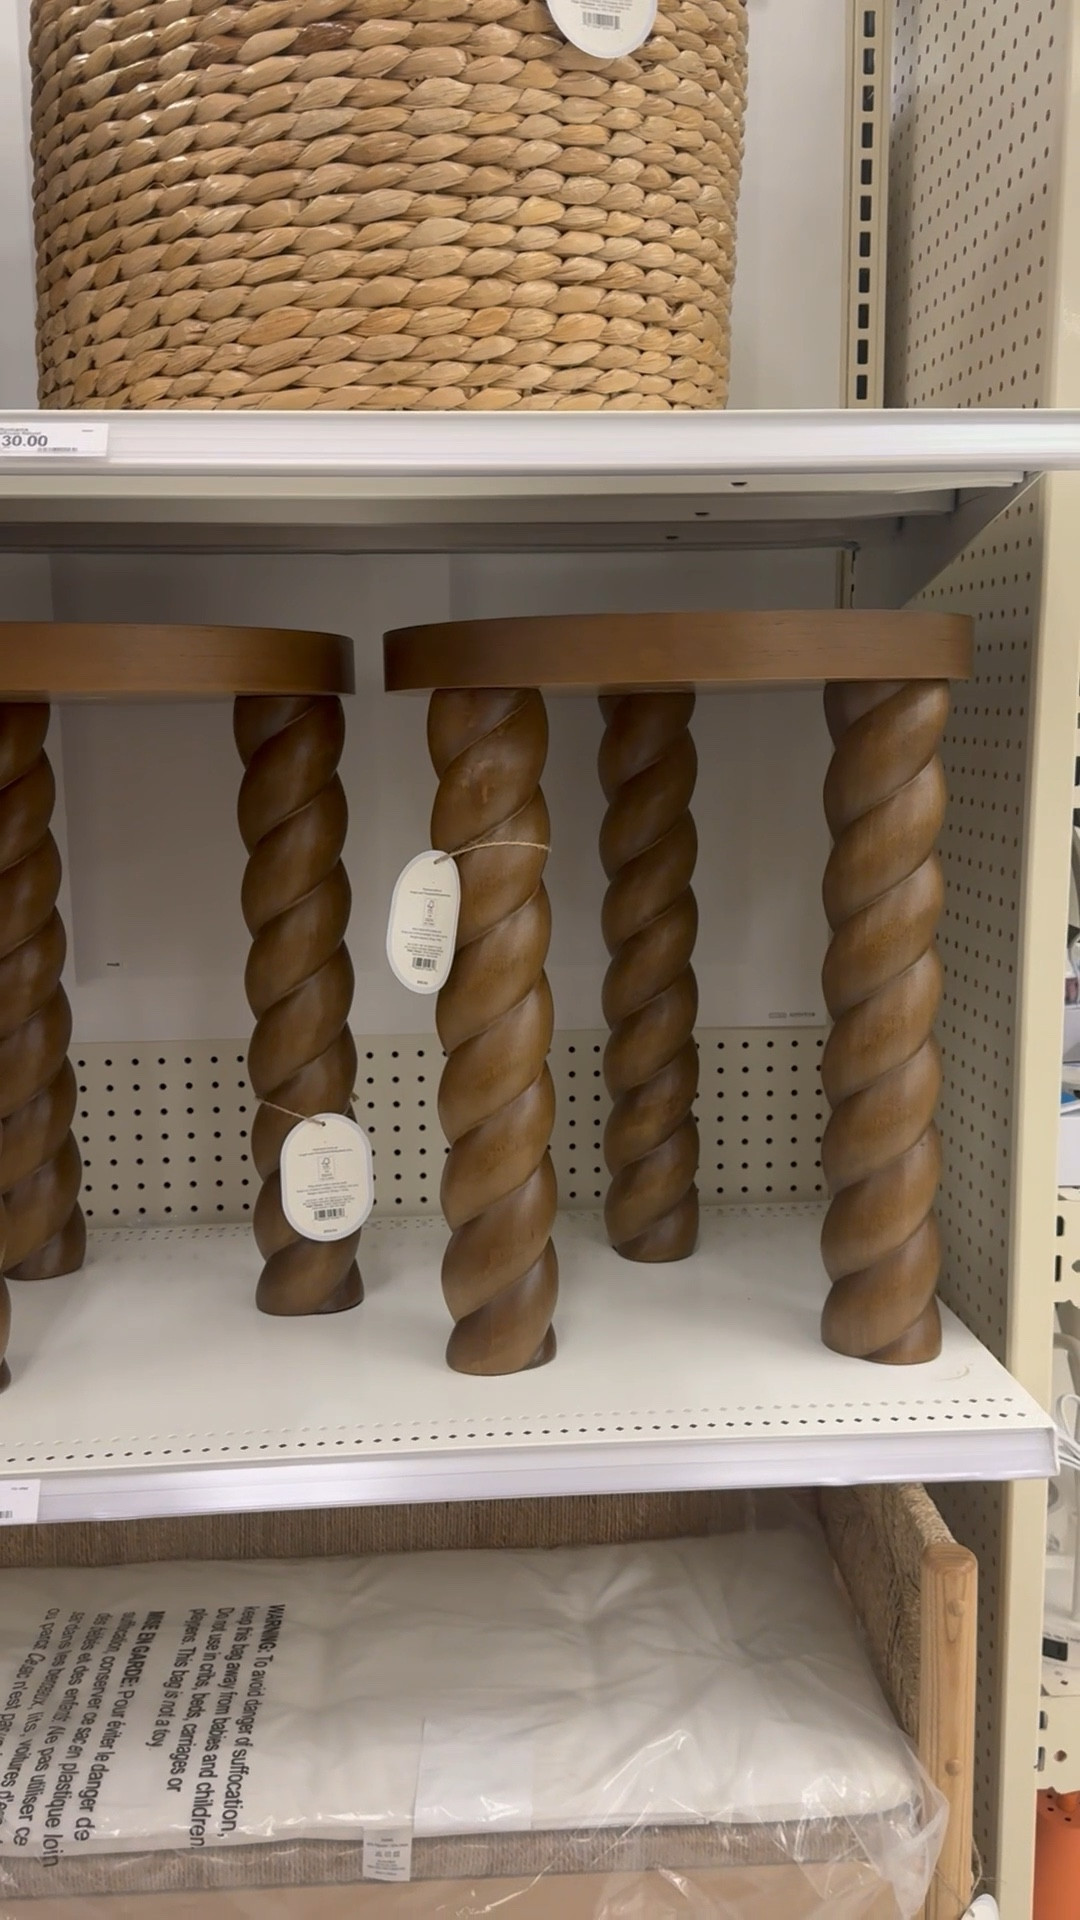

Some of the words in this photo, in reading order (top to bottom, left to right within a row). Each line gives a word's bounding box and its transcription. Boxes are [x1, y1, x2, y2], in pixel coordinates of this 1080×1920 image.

[217, 1608, 234, 1618] Do
[58, 1624, 79, 1649] dans
[136, 1633, 155, 1644] EN
[258, 1605, 285, 1653] WARNING:
[206, 1634, 222, 1650] use
[225, 1644, 248, 1660] bag
[25, 1653, 46, 1665] Ce
[52, 1650, 72, 1666] les
[76, 1653, 92, 1663] et
[120, 1646, 150, 1687] GARDE:
[173, 1647, 196, 1667] This
[203, 1653, 221, 1661] in
[254, 1656, 273, 1667] To
[68, 1666, 89, 1685] des
[87, 1656, 116, 1709] conserver
[163, 1671, 189, 1688] bag
[192, 1664, 216, 1690] cribs,
[217, 1663, 240, 1689] away
[247, 1671, 265, 1696] avoid
[4, 1681, 28, 1710] n'est
[111, 1690, 135, 1718] Pour
[183, 1693, 210, 1720] beds,
[216, 1692, 237, 1714] from
[82, 1712, 97, 1724] ce
[158, 1701, 176, 1717] not
[236, 1700, 261, 1734] danger
[19, 1712, 44, 1737] lits,
[44, 1726, 66, 1743] Ne
[72, 1727, 92, 1743] sac
[99, 1721, 126, 1749] éviter
[205, 1718, 231, 1751] babies
[65, 1746, 83, 1758] en
[169, 1724, 196, 1774] carriages
[235, 1738, 253, 1746] of
[0, 1739, 33, 1788] voitures
[35, 1747, 55, 1771] pas
[95, 1752, 115, 1762] le
[199, 1754, 218, 1777] and
[45, 1763, 79, 1828] plastique
[79, 1764, 109, 1812] danger
[167, 1778, 183, 1792] or
[218, 1750, 249, 1838] suffocation,
[19, 1775, 46, 1821] utiliser
[14, 1828, 31, 1846] ce
[74, 1817, 95, 1841] de
[43, 1835, 63, 1867] loin
